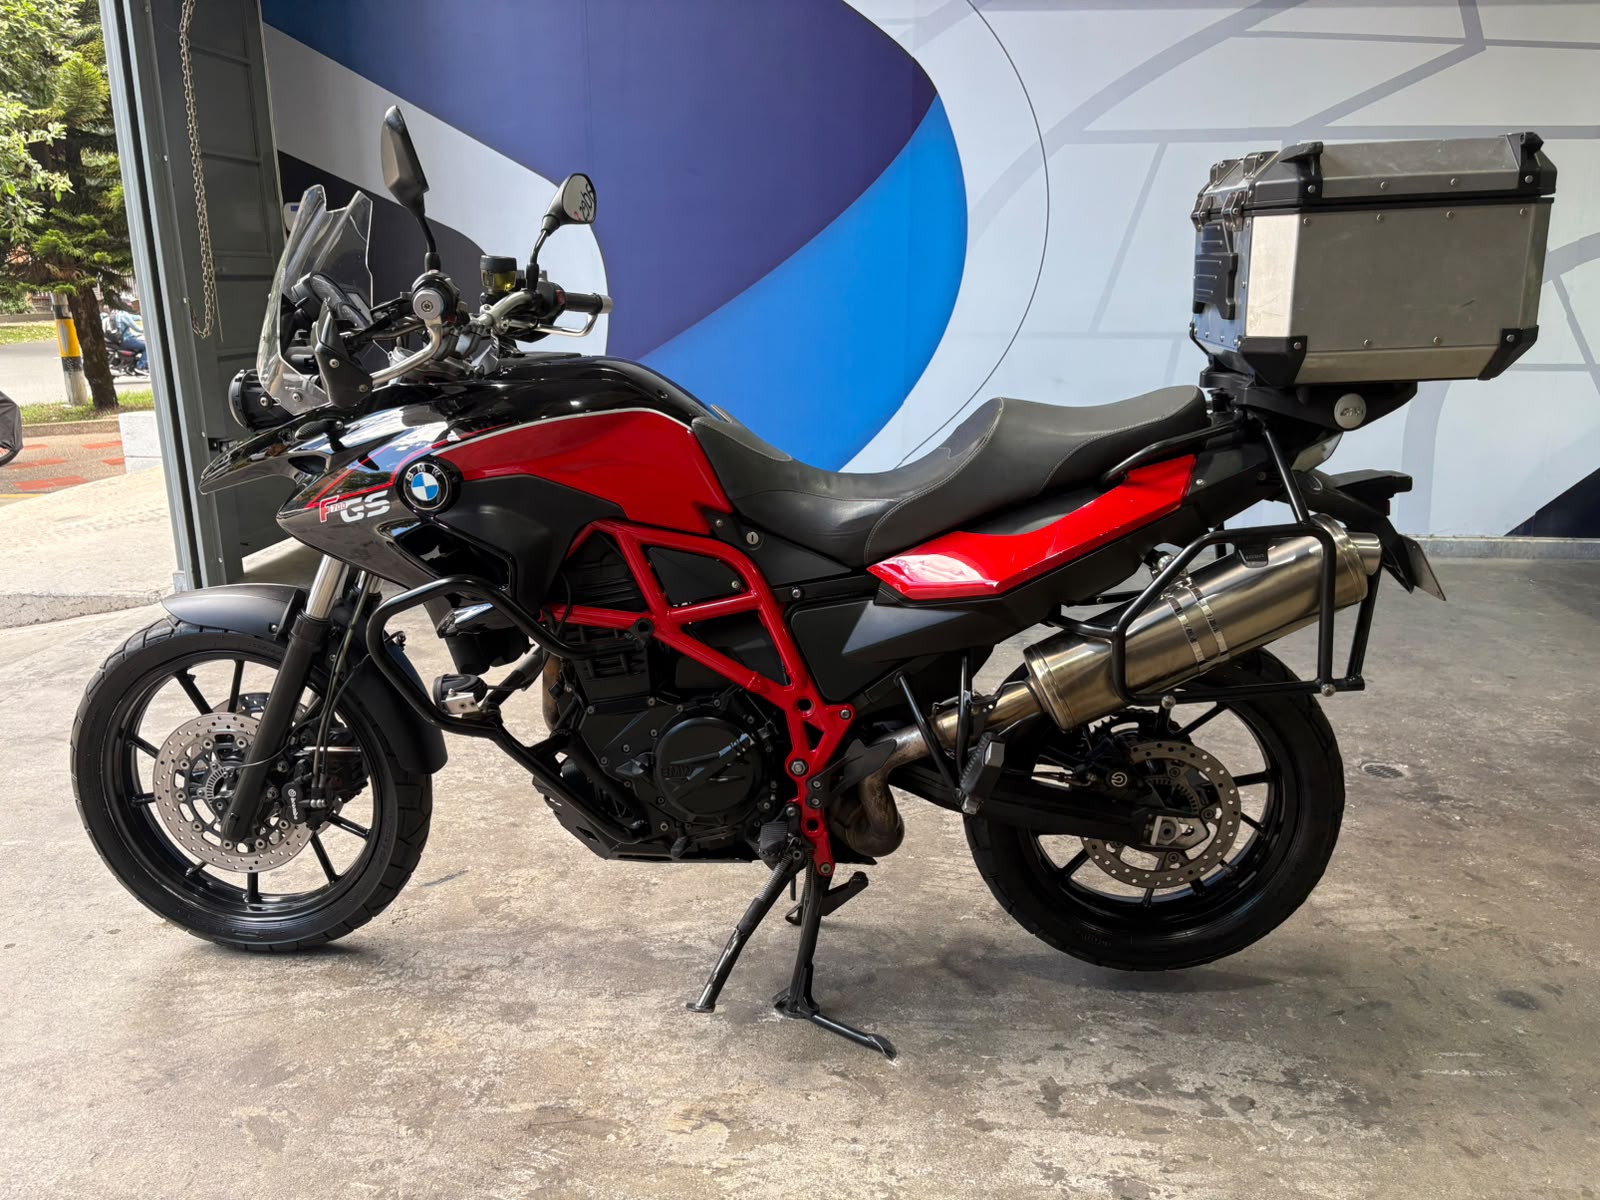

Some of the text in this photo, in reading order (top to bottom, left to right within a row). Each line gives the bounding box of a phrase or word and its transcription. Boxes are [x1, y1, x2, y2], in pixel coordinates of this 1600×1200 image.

[405, 463, 442, 481] BMW
[340, 490, 391, 523] GS
[661, 767, 692, 777] BMW
